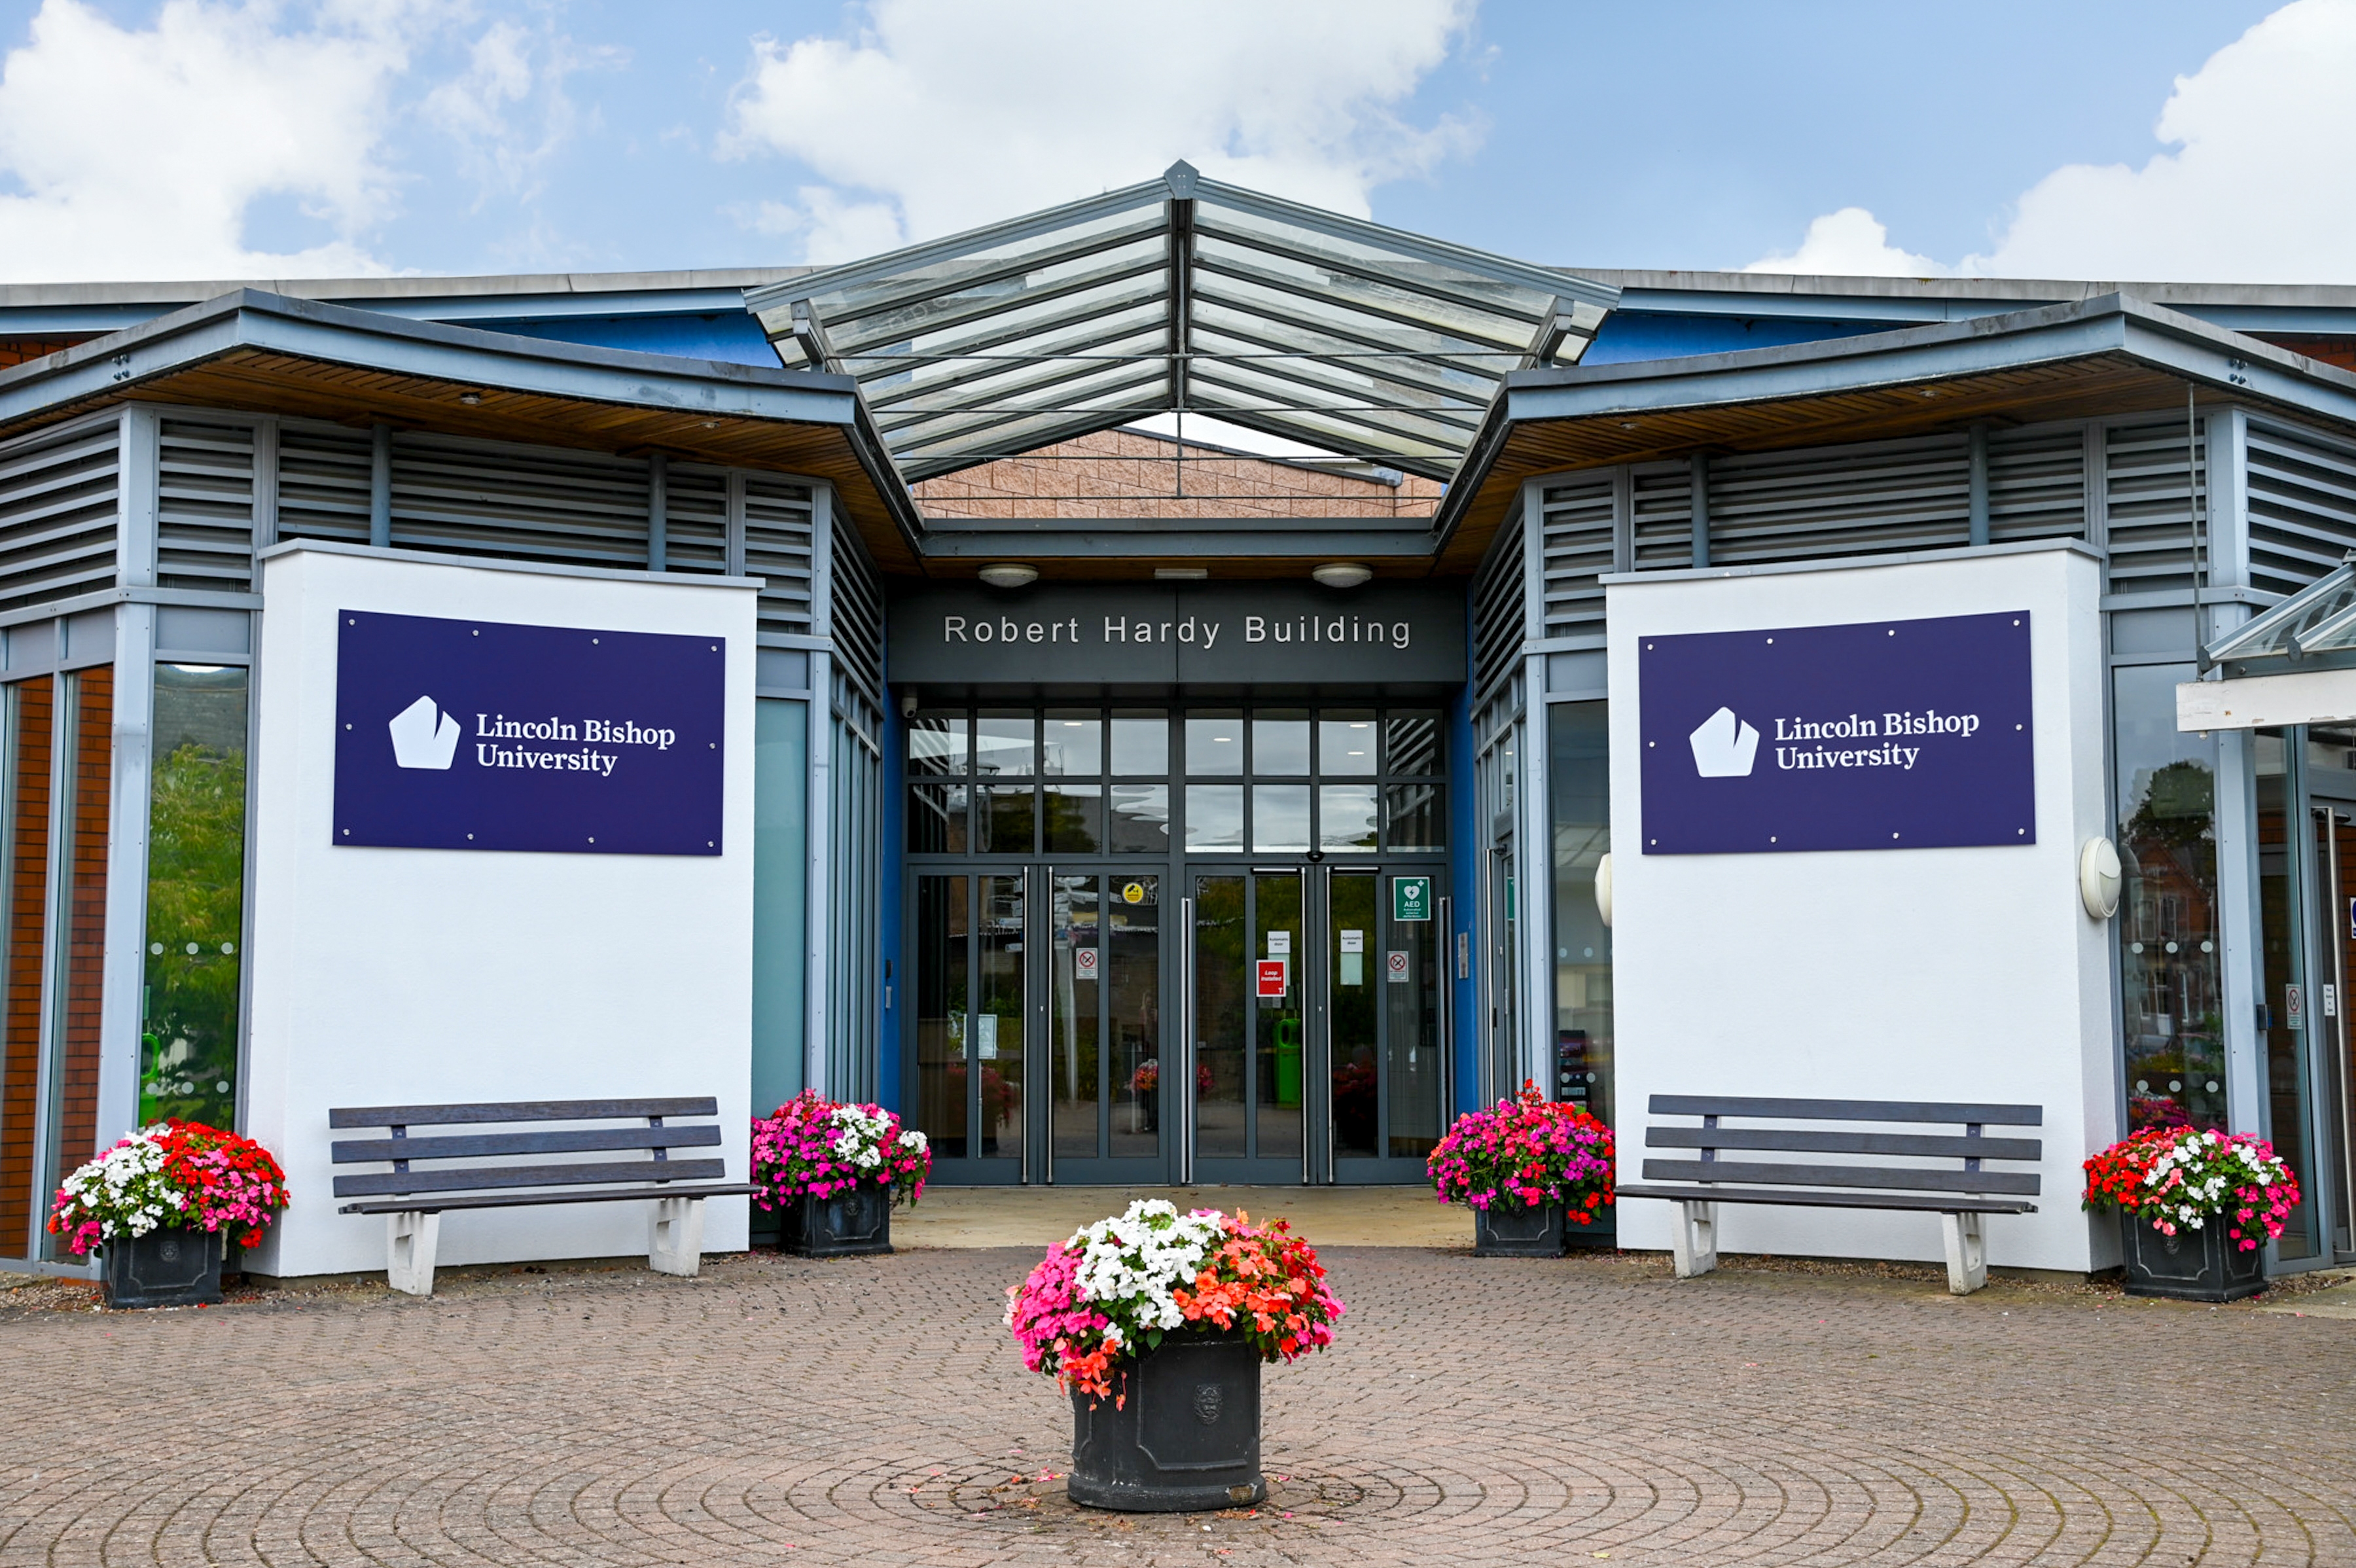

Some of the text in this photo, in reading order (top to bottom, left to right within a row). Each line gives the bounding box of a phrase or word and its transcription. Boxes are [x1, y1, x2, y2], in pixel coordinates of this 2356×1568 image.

[944, 615, 1410, 650] Robert Hardy Building
[476, 713, 675, 751] Lincoln Bishop
[1774, 709, 1980, 741] Lincoln Bishop
[476, 743, 618, 777] University
[1775, 741, 1920, 770] University
